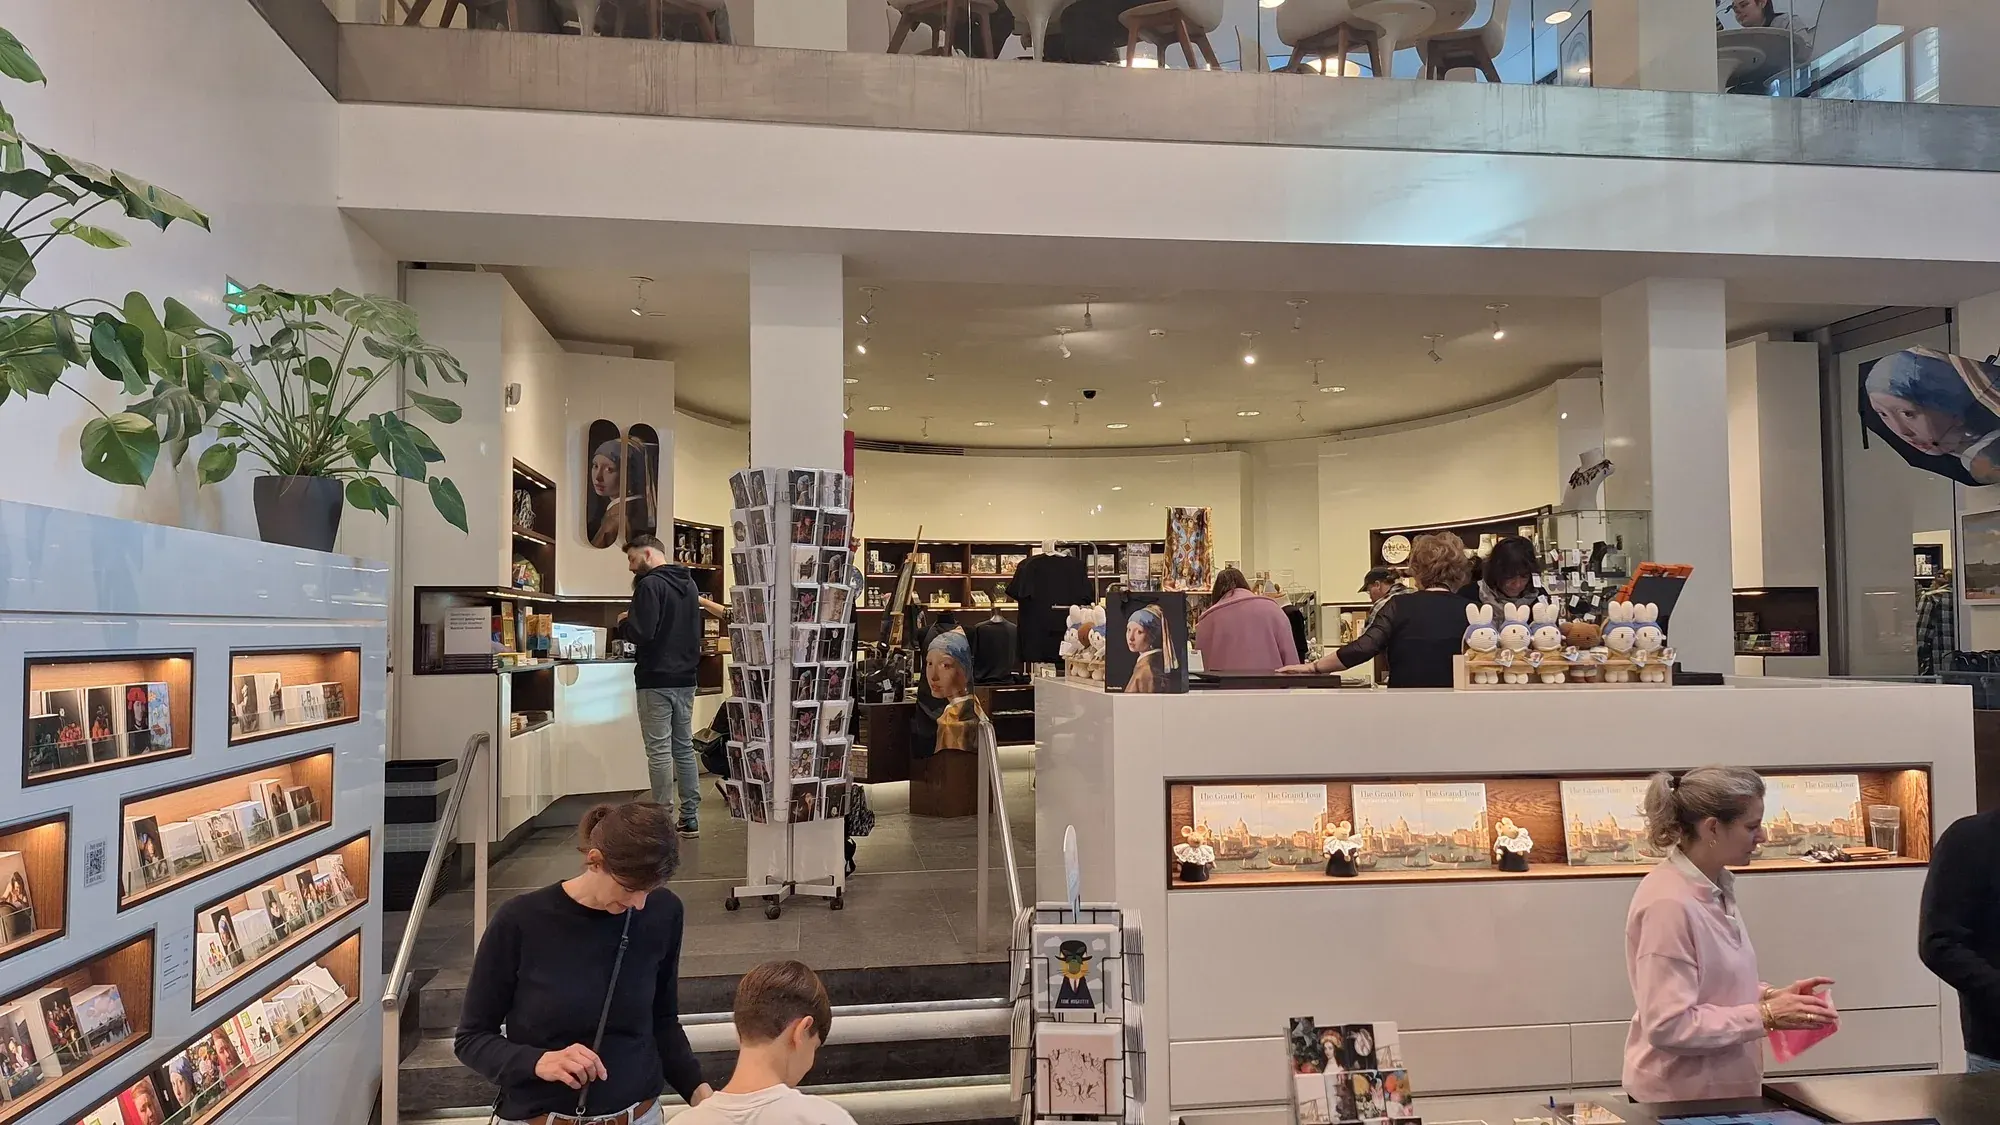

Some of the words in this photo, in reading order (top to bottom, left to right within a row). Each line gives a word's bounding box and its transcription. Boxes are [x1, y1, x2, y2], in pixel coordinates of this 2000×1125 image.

[1805, 781, 1816, 789] The
[1817, 781, 1838, 789] Grand
[1200, 792, 1213, 800] The
[1214, 792, 1237, 800] Grand
[1240, 792, 1256, 800] Tour
[1267, 791, 1280, 800] The
[1281, 791, 1303, 800] Grand
[1306, 791, 1321, 799] Tour
[1360, 790, 1373, 798] The
[1375, 790, 1397, 798] Grand
[1399, 790, 1414, 798] Tour
[1425, 789, 1438, 797] The
[1439, 789, 1462, 797] Grand
[1464, 789, 1480, 797] Tour
